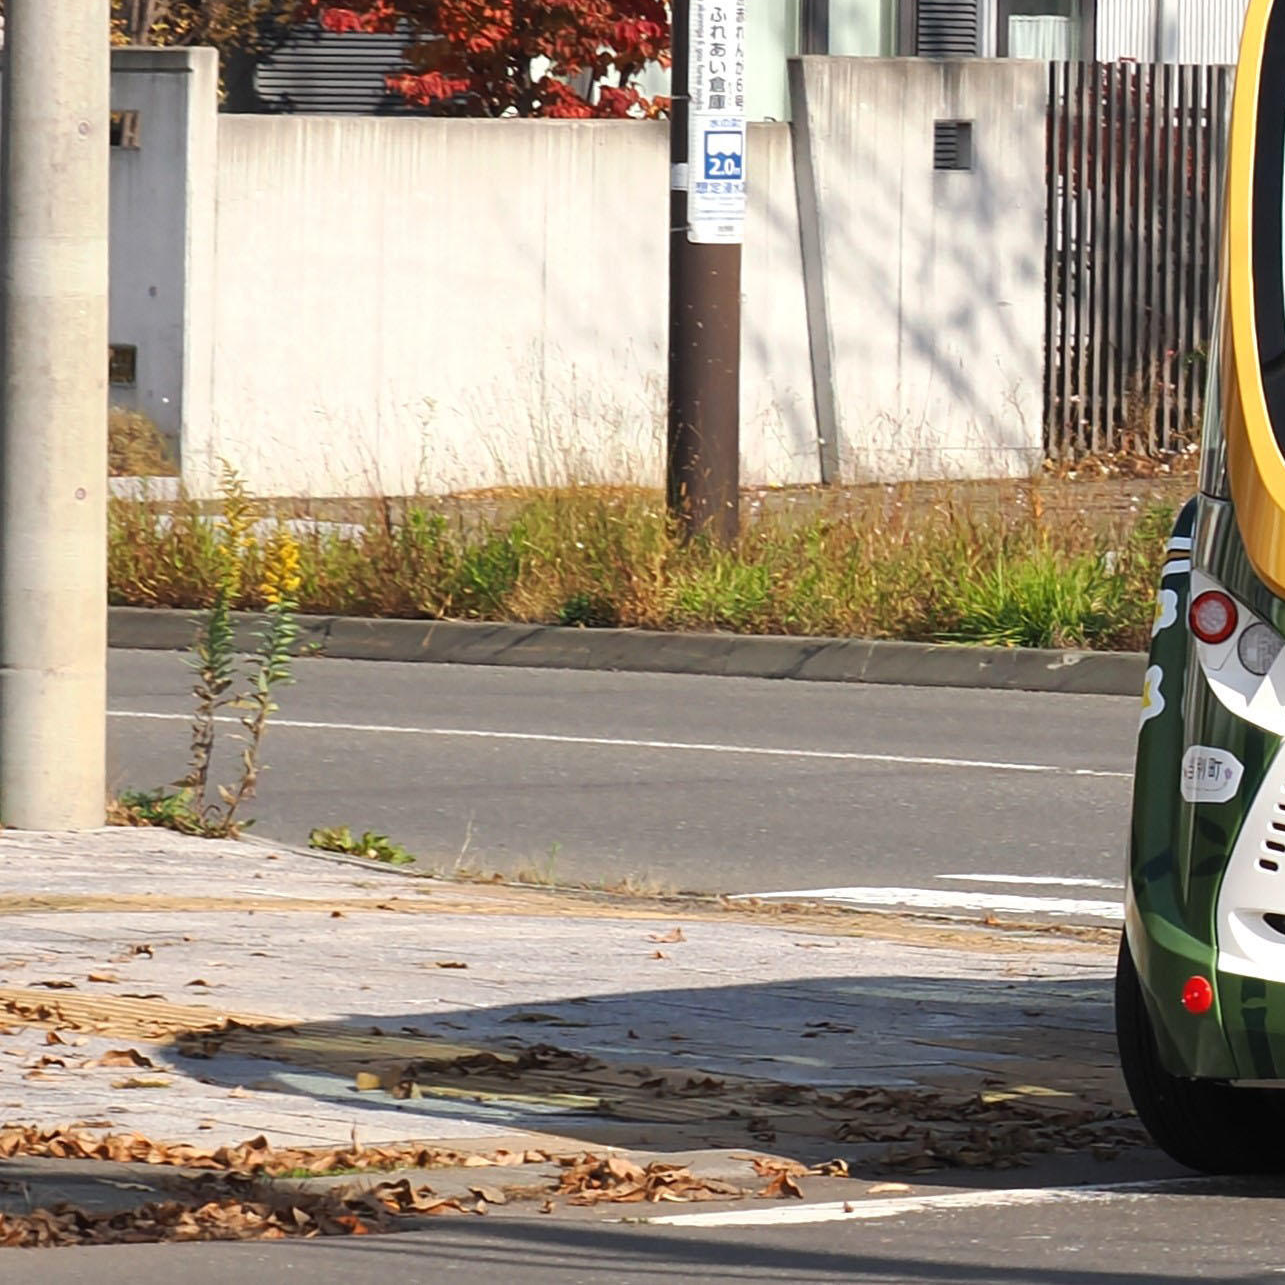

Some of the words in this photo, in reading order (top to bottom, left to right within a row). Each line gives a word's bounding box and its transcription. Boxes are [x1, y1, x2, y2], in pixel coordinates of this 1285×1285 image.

[708, 6, 727, 110] ふれあい倉庫
